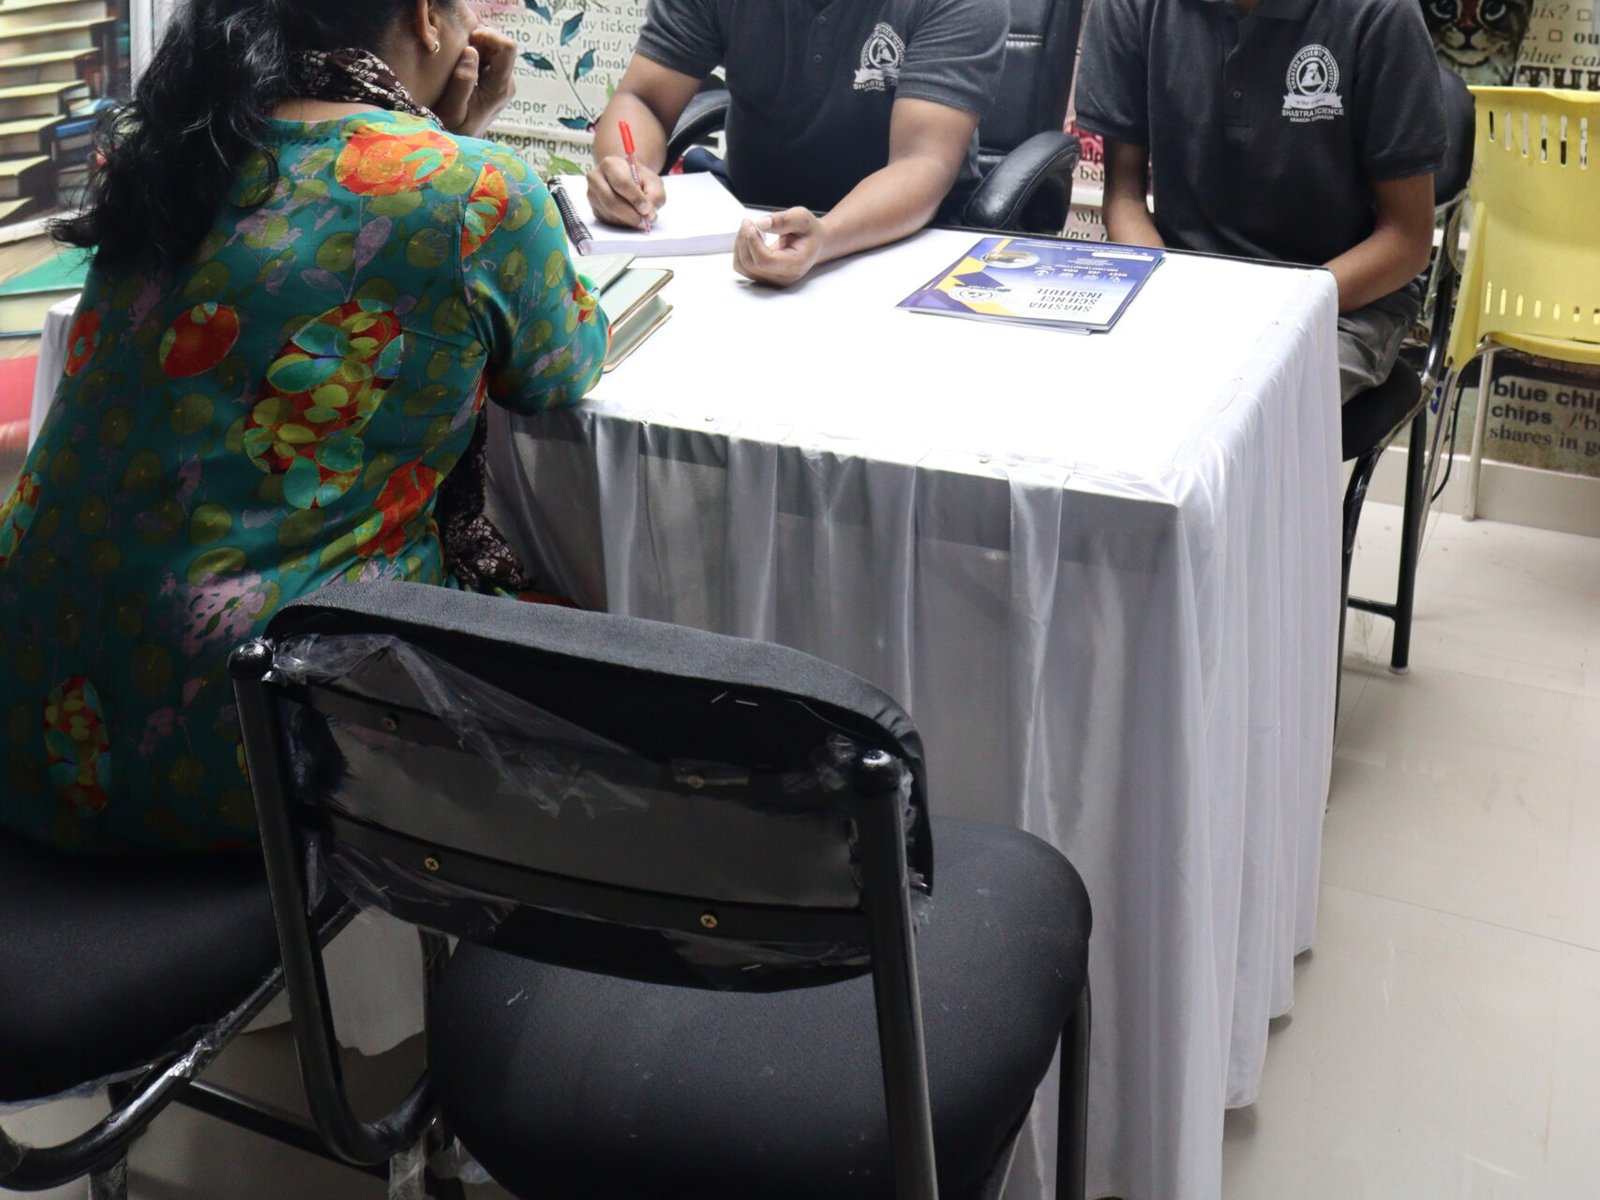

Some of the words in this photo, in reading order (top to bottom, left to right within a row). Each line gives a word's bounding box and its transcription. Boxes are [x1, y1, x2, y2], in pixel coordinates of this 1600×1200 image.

[1281, 108, 1315, 118] SHASTRA
[1315, 107, 1345, 117] SCIENCE
[1028, 301, 1093, 313] SHASTRA
[1040, 295, 1099, 306] SCIENCE
[1493, 378, 1548, 402] blue
[1490, 404, 1553, 426] chips
[1489, 423, 1553, 446] shares
[1558, 431, 1578, 451] in
